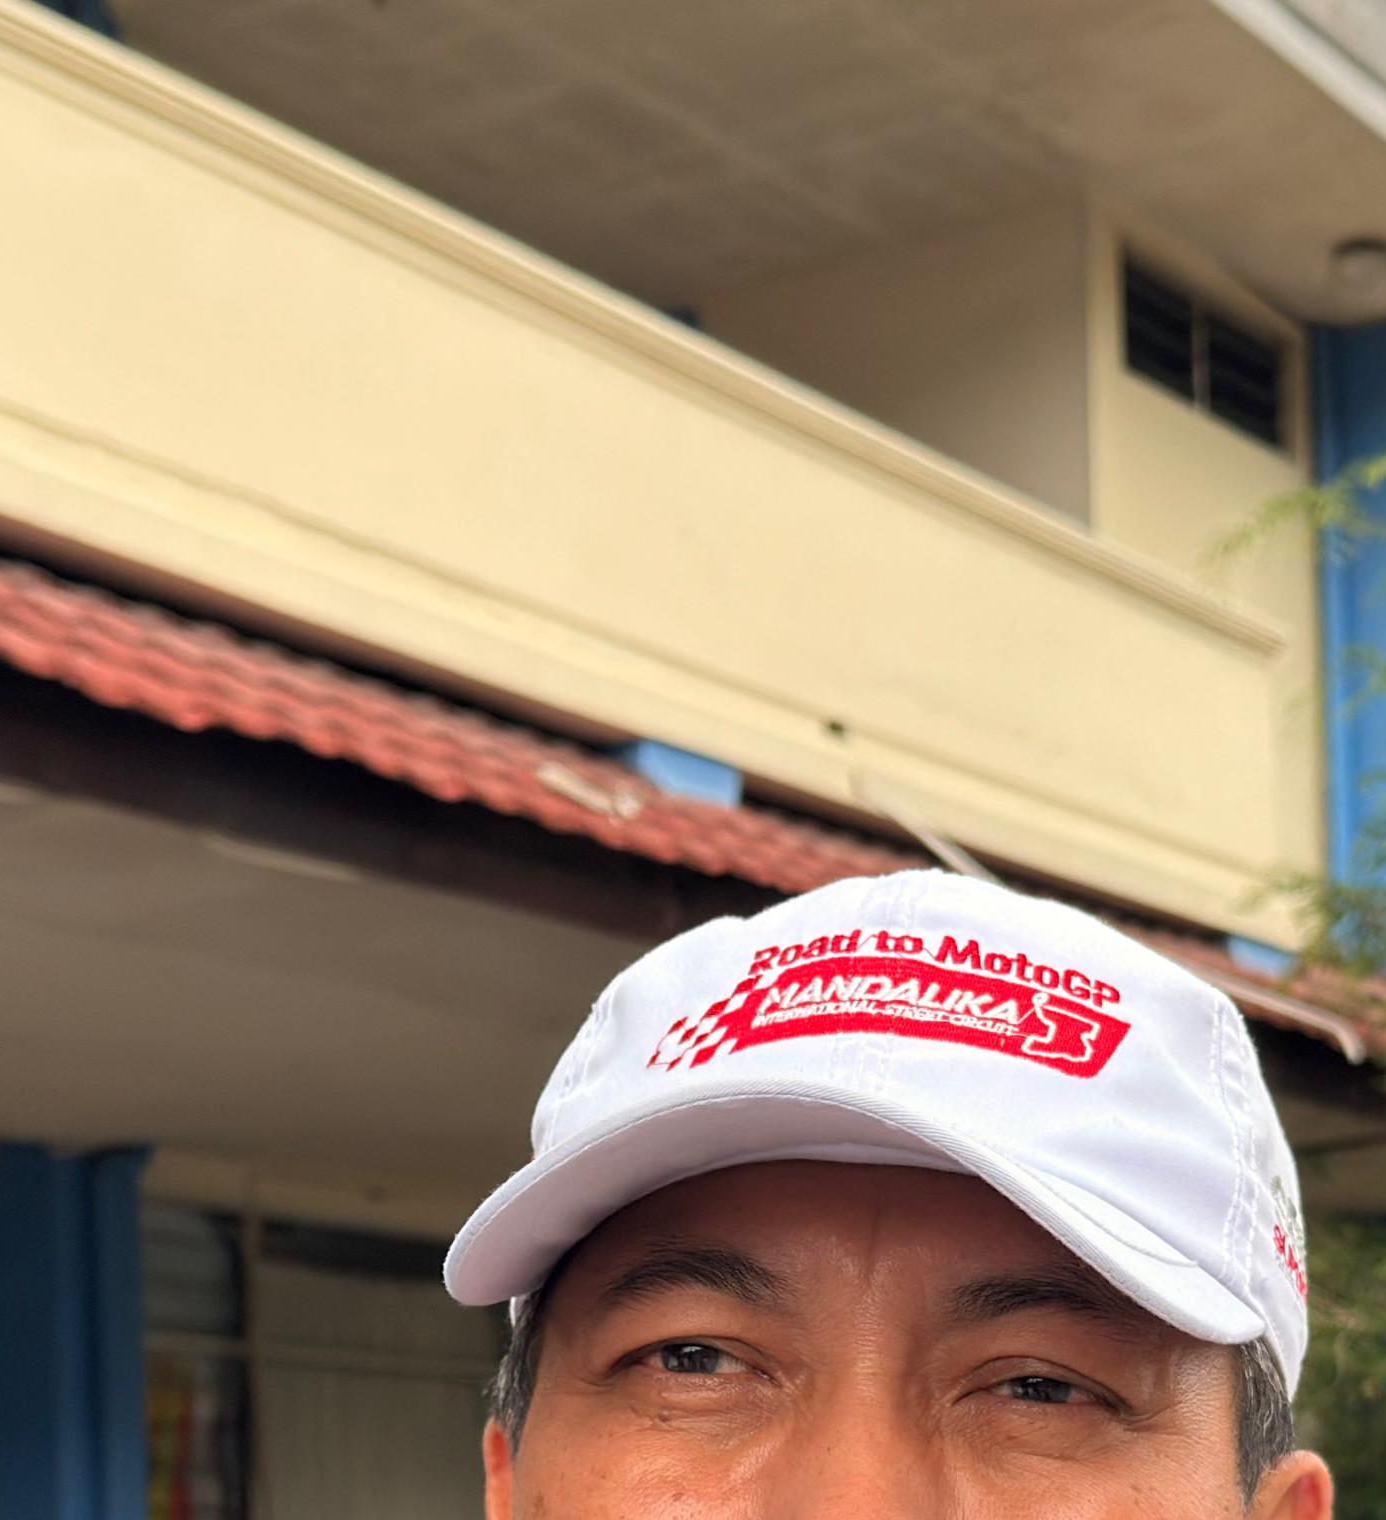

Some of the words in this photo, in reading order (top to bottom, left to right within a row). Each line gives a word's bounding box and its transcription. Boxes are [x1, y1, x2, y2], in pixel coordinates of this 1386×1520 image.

[748, 929, 862, 976] Road
[875, 930, 924, 954] to
[934, 935, 1121, 1008] MotoGP
[756, 975, 1019, 1025] MANDALIKA
